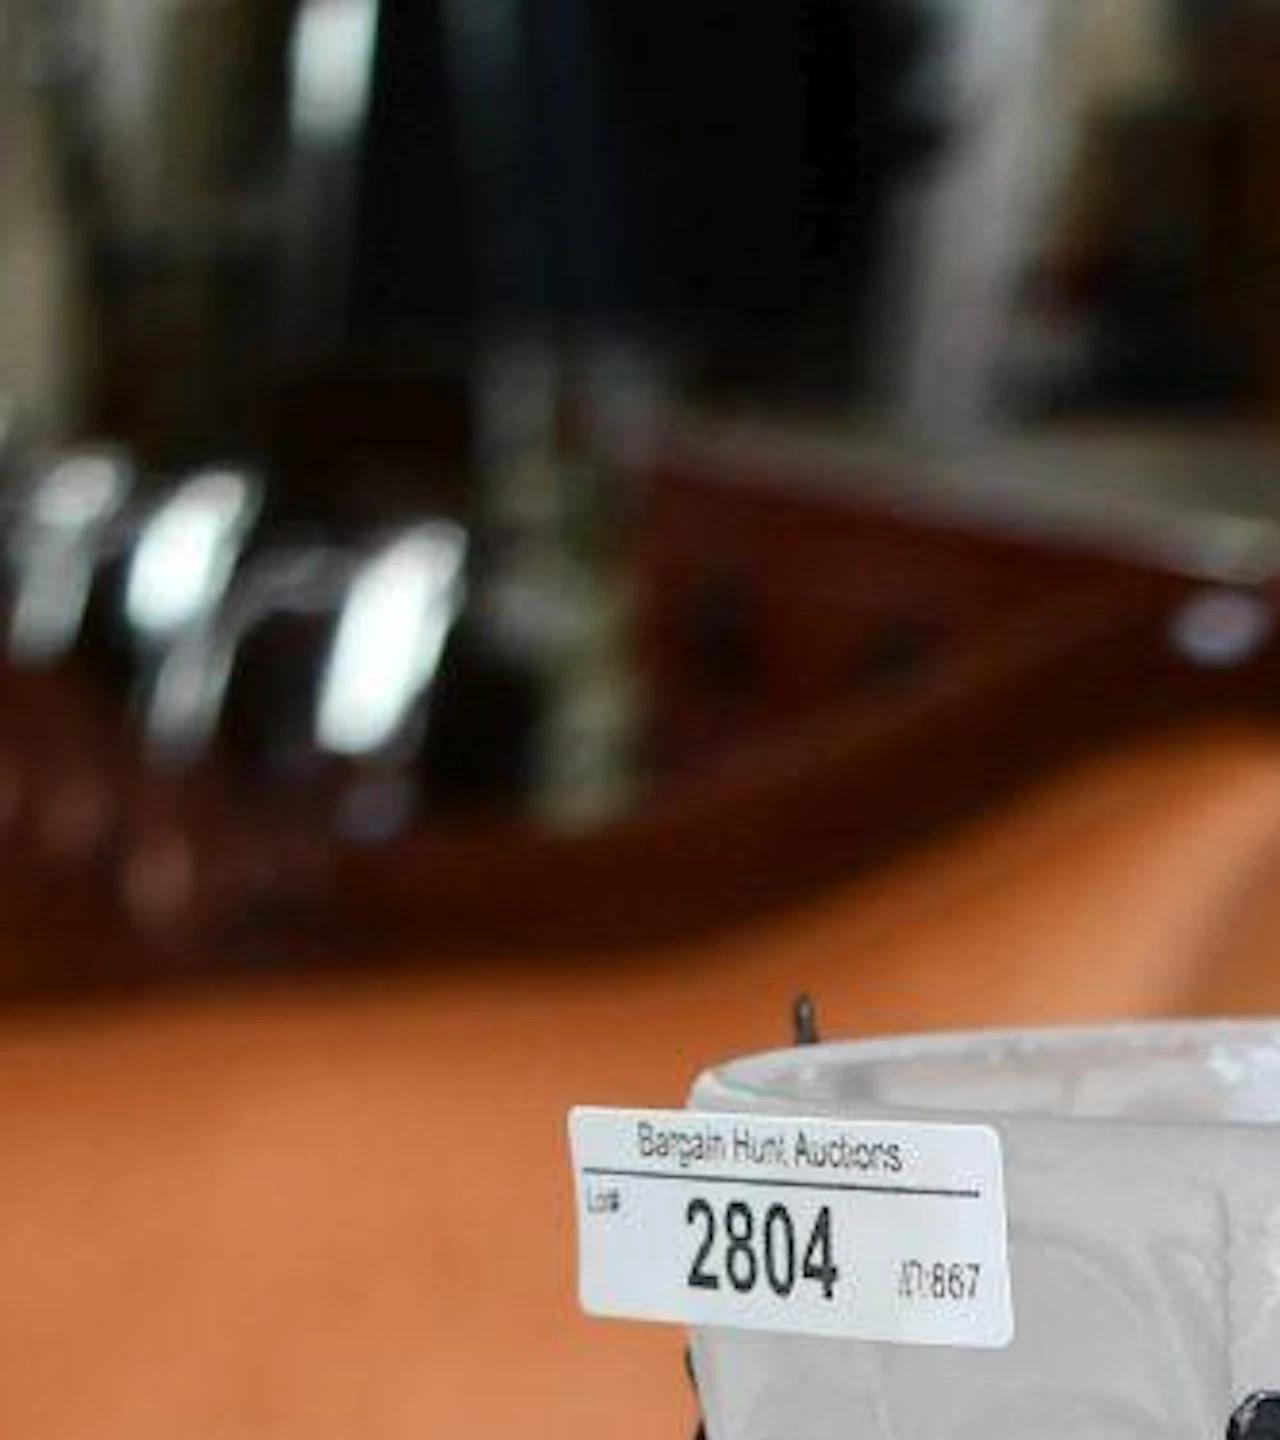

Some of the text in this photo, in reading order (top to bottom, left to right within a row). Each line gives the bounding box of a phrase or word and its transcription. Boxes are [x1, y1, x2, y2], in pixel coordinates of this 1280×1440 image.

[637, 1122, 903, 1173] Bargain Hunt Auctions
[686, 1198, 840, 1300] 2804
